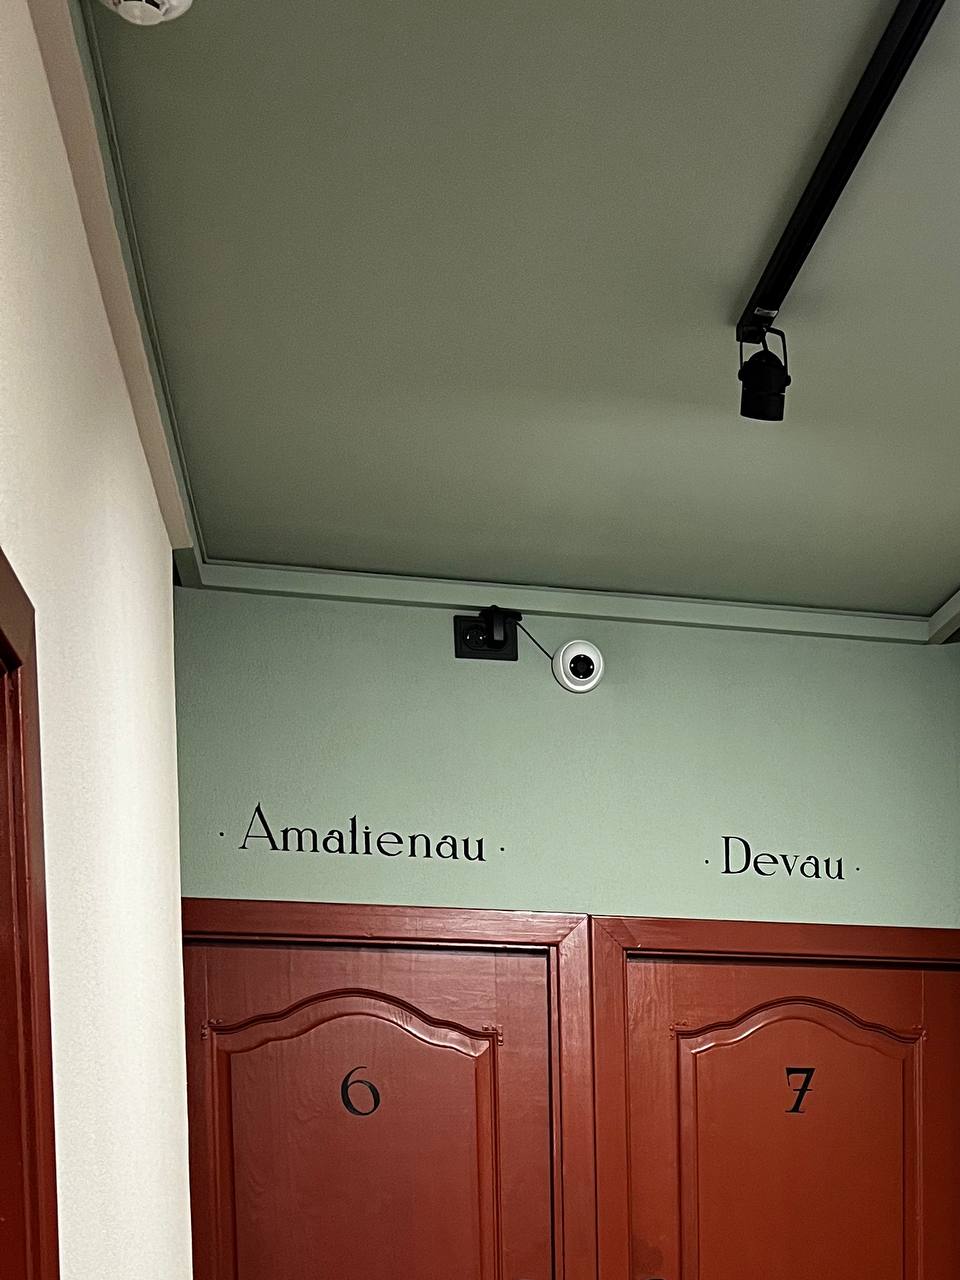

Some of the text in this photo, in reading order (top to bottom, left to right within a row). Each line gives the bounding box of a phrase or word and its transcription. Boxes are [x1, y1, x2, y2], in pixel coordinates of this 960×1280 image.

[238, 801, 487, 862] Amalienau
[721, 835, 845, 880] Devau
[340, 1066, 381, 1116] 6
[784, 1066, 816, 1114] 7
